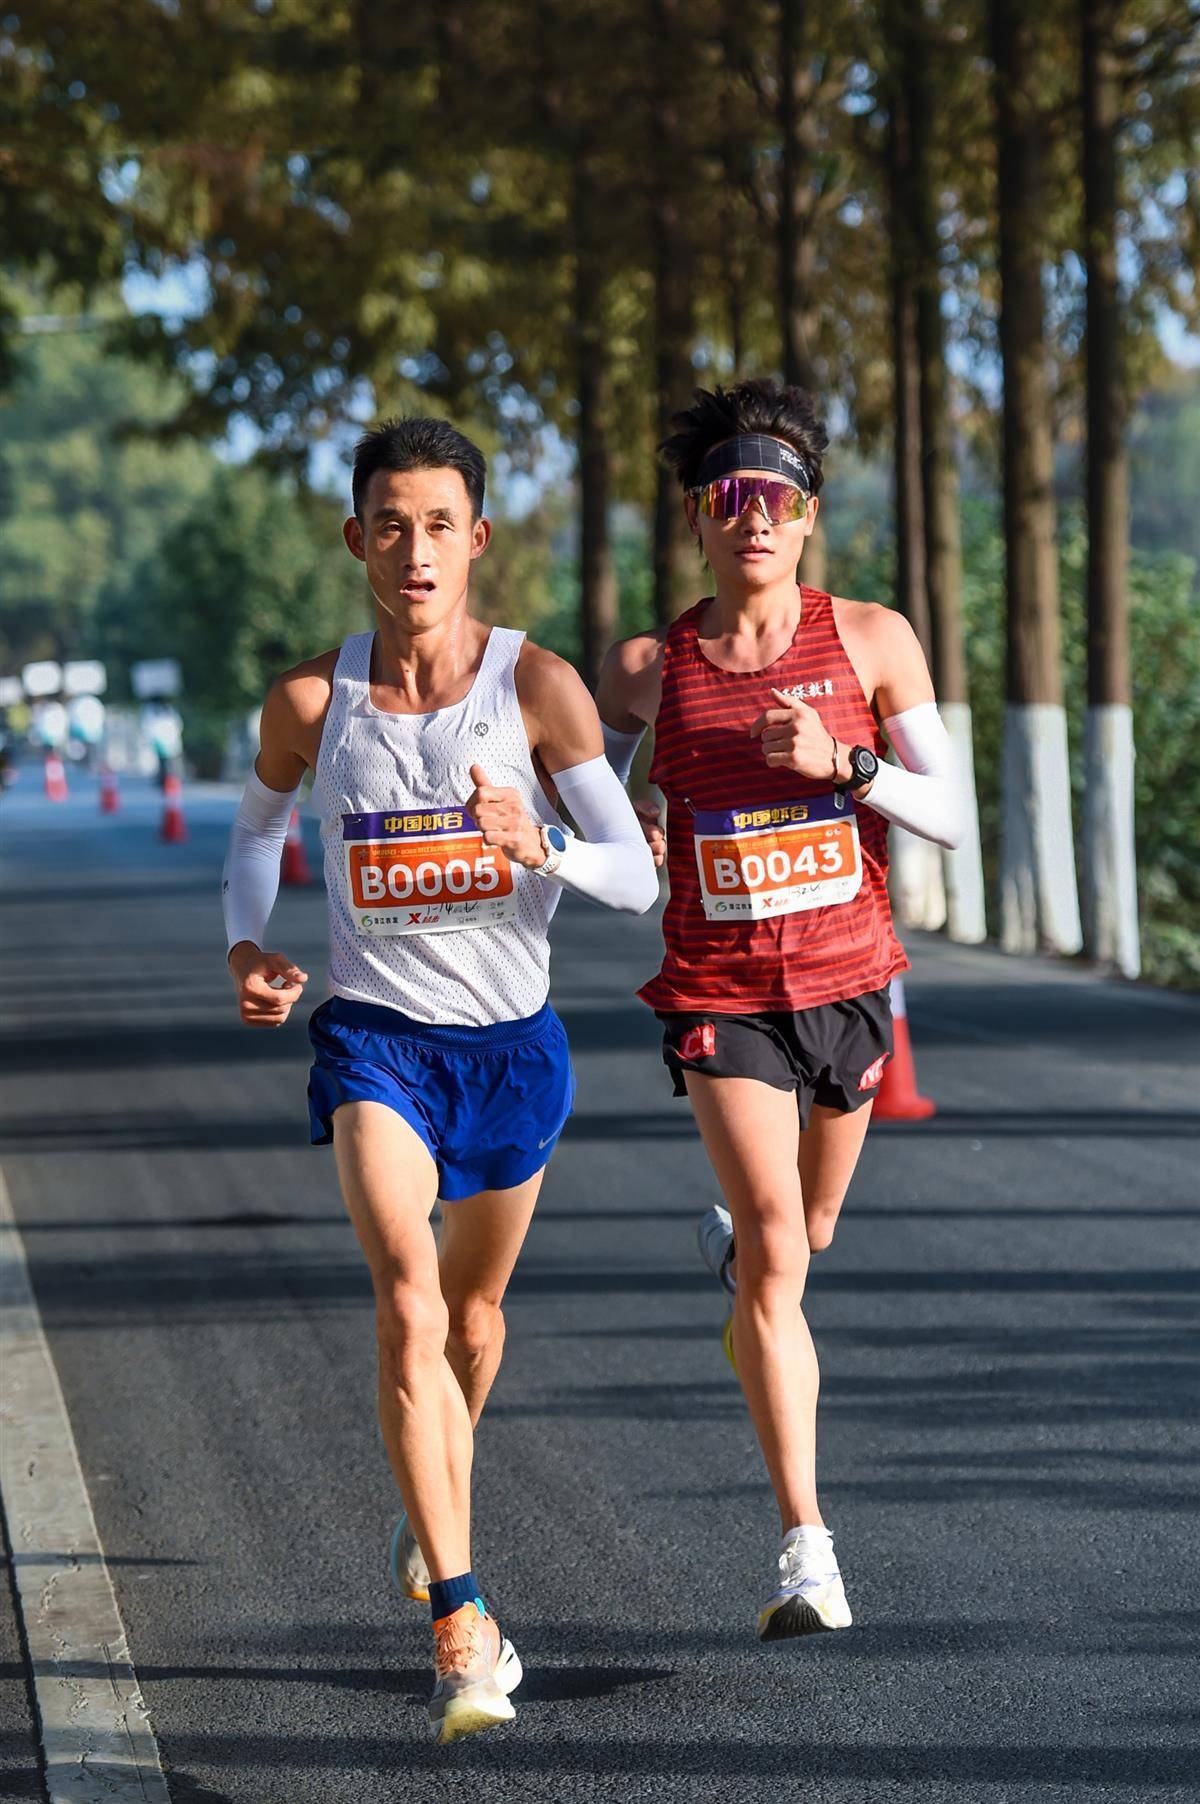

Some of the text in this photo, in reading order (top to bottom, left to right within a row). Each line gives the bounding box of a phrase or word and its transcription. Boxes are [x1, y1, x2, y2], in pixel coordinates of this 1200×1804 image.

[384, 812, 464, 834] 中国虾谷
[733, 805, 809, 828] 中国虾谷
[360, 856, 500, 901] B0005
[713, 841, 843, 889] B0043
